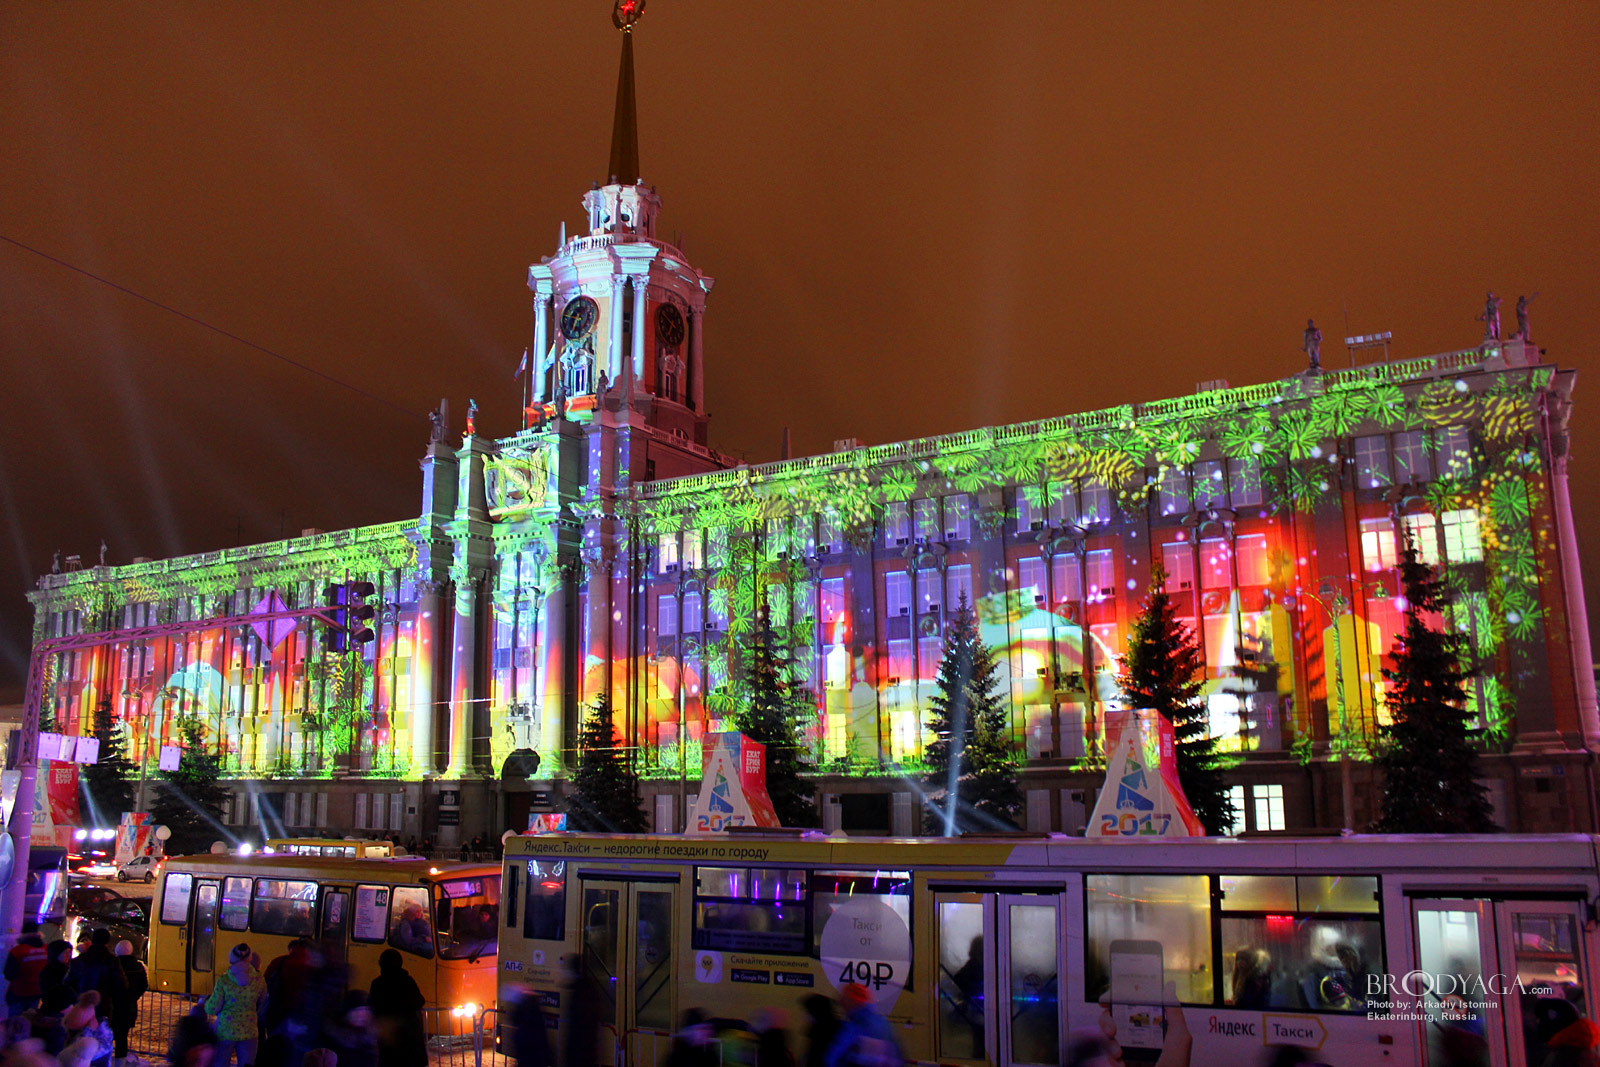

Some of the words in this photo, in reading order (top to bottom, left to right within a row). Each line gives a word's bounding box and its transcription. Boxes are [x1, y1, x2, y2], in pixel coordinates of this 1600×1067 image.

[698, 815, 745, 832] 2017
[1101, 813, 1171, 836] 2017
[523, 841, 590, 854] Яндекс.Такси
[604, 844, 660, 856] недорогие
[663, 846, 708, 857] поездки
[711, 847, 725, 857] по
[728, 848, 769, 860] городу
[376, 892, 387, 904] 48
[852, 917, 882, 931] Такси
[860, 937, 872, 946] от
[504, 961, 523, 971] АП-6
[730, 955, 763, 965] Скачайте
[764, 958, 809, 968] приложение
[1208, 1015, 1256, 1036] Яндекс
[1273, 1023, 1313, 1038] Такси
